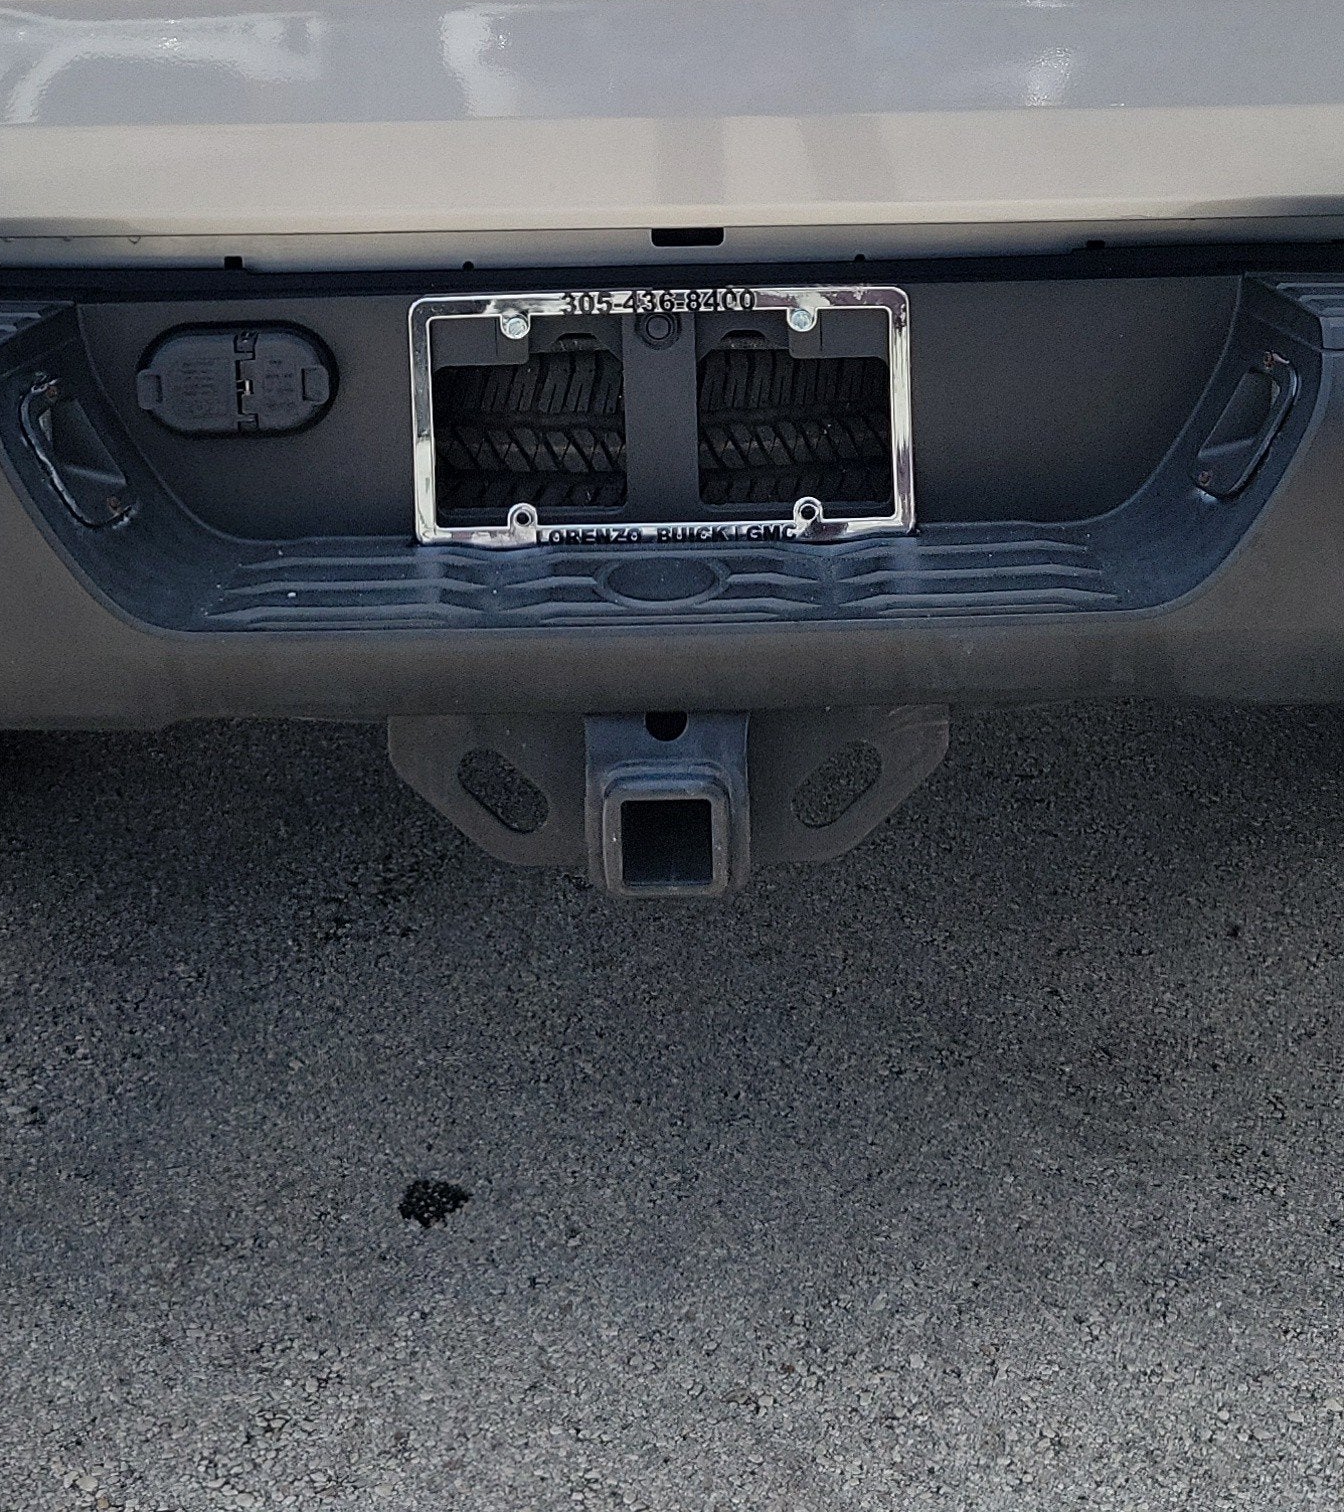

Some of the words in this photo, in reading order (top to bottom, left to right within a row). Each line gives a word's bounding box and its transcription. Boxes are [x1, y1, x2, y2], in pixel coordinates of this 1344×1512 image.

[561, 288, 757, 315] 305-436-8400
[536, 527, 645, 546] LORENZO
[655, 523, 729, 544] BUICK
[744, 522, 799, 543] GMC
